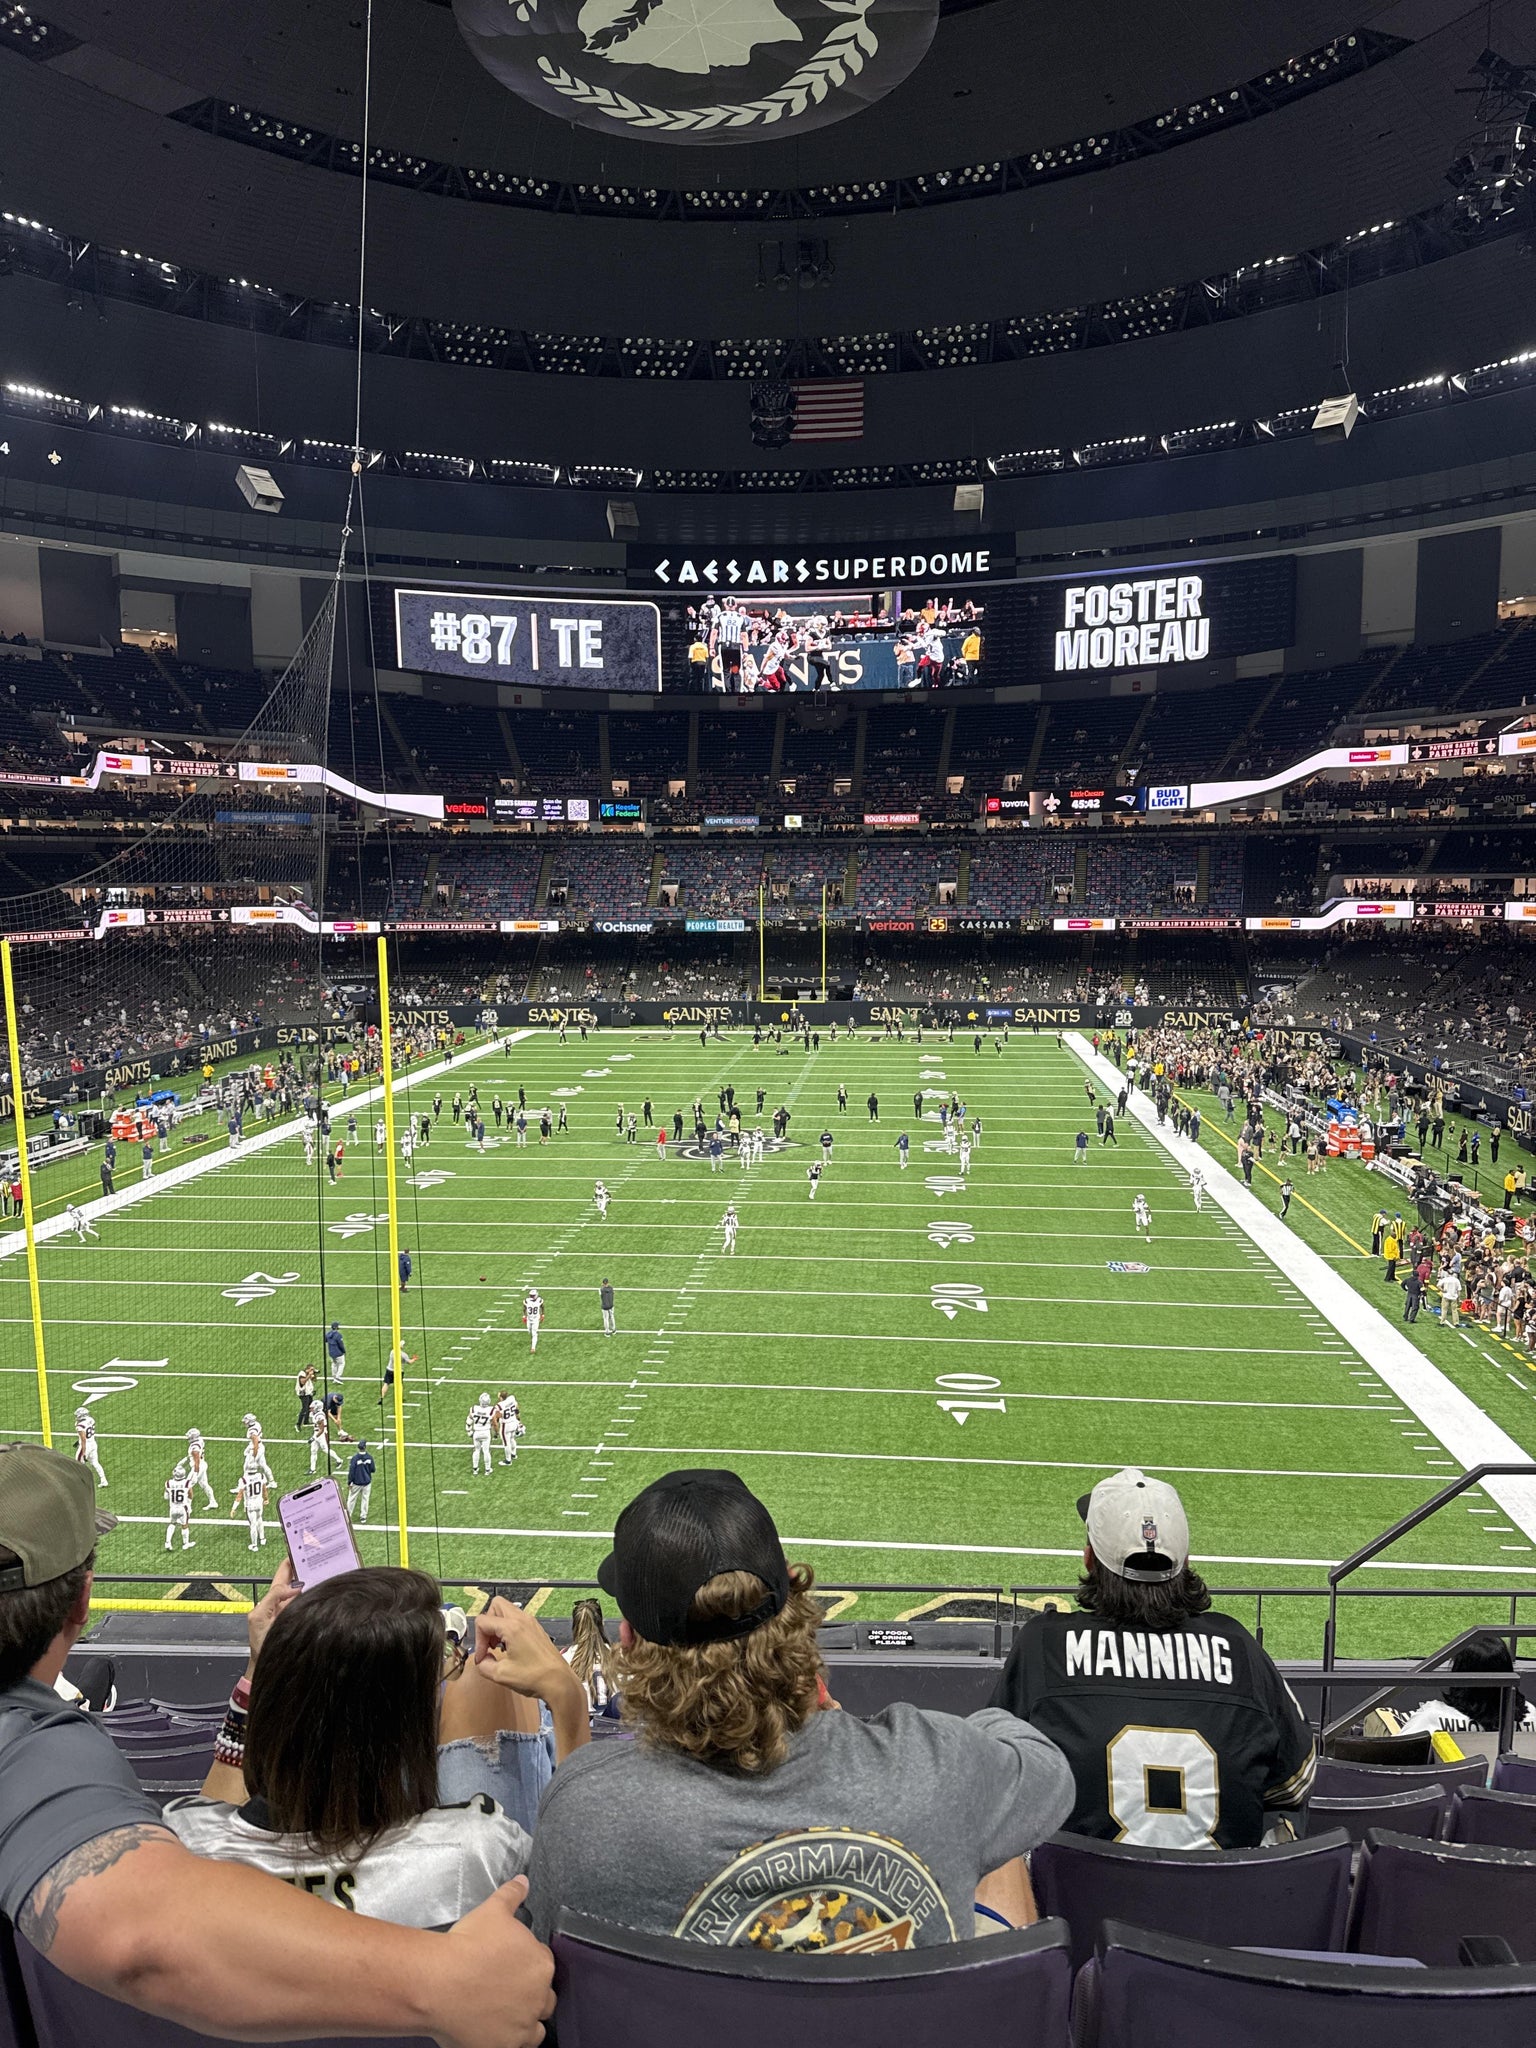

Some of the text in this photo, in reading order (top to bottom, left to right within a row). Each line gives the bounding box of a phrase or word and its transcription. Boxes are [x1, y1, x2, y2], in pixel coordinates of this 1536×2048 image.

[654, 550, 990, 584] CAESARS SUPERDOME
[1064, 575, 1203, 629] FOSTER
[430, 611, 604, 668] #87 TE
[1055, 617, 1210, 672] MOREAU
[1429, 747, 1478, 758] PARTNERS
[1156, 788, 1180, 798] BUD
[1494, 794, 1526, 803] SAINTS
[1152, 798, 1185, 807] LIGHT
[1355, 800, 1386, 808] SAINTS
[1425, 797, 1456, 806] SAINTS
[20, 807, 48, 816] SAINTS
[83, 809, 112, 817] SAINTS
[445, 803, 485, 814] verizon
[706, 817, 760, 825] VENTURE GLOBAL
[890, 814, 919, 823] MARKETS
[945, 813, 972, 821] SAINTS
[1434, 908, 1485, 916] PARTNERS
[561, 920, 590, 928] SAINTS
[602, 921, 653, 932] Ochsner
[686, 920, 744, 930] PEOPLES HEALTH
[868, 921, 915, 931] verizon
[930, 919, 946, 930] 25
[959, 920, 1011, 929] CAESARS
[1020, 918, 1050, 927] SAINTS
[388, 1009, 449, 1026] SAINTS
[481, 1011, 499, 1023] 20
[1014, 1007, 1080, 1023] SAINTS
[1115, 1011, 1133, 1025] 20
[1163, 1010, 1234, 1029] SAINTS
[200, 1038, 238, 1063] SAINTS
[105, 1060, 151, 1088] SAINTS
[924, 1176, 967, 1192] 40
[927, 1221, 975, 1244] 30
[221, 1271, 300, 1298] 20
[930, 1283, 989, 1313] 20
[72, 1357, 170, 1393] 10
[935, 1373, 1006, 1413] 10
[503, 1405, 518, 1420] 65
[473, 1415, 489, 1426] 77
[248, 1481, 261, 1497] 10
[170, 1489, 185, 1503] 16
[1065, 1628, 1234, 1686] MANNING
[692, 1844, 938, 1945] RFORMANCE
